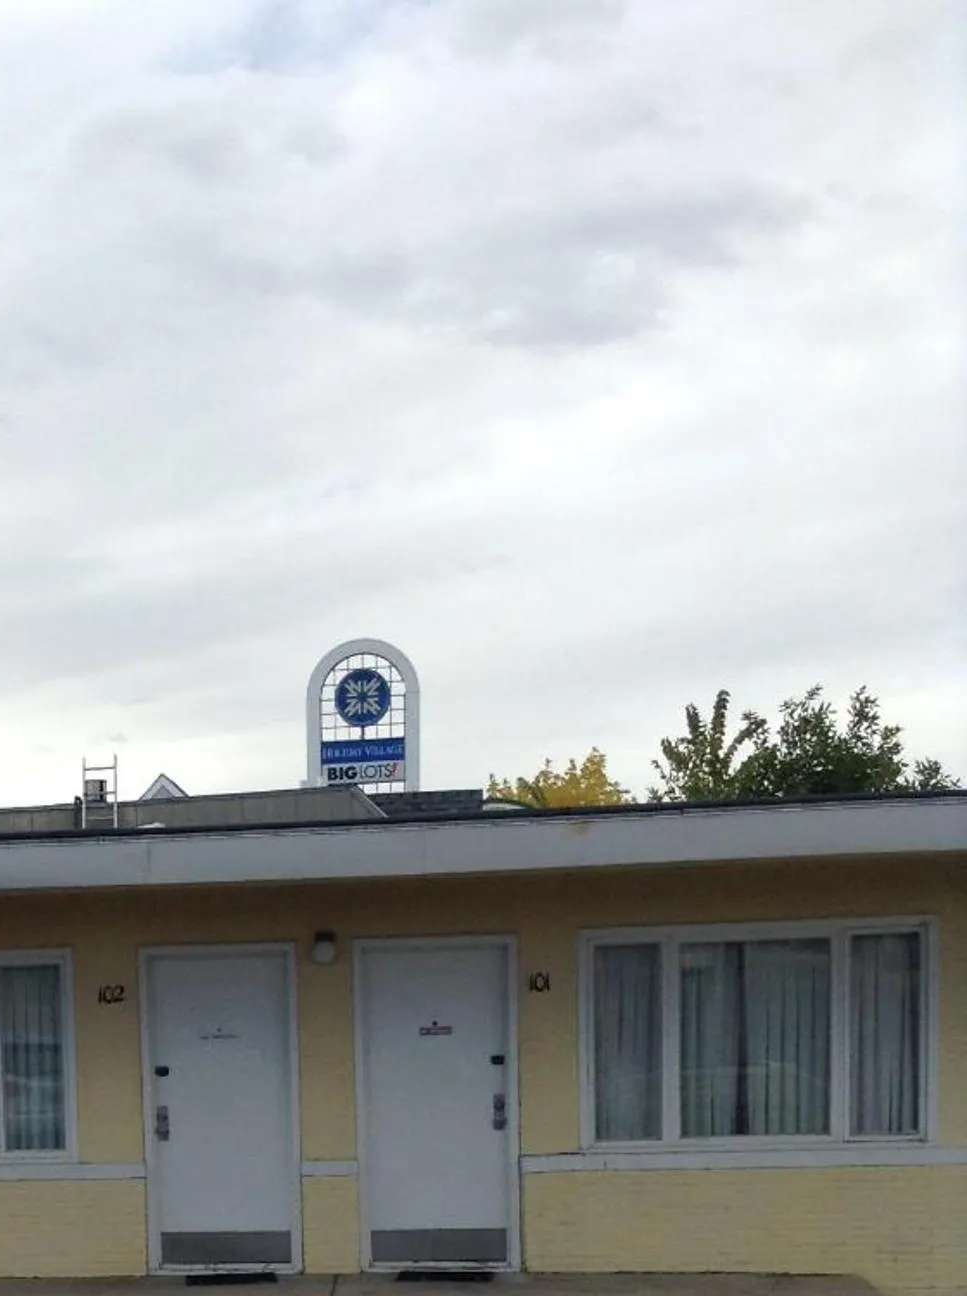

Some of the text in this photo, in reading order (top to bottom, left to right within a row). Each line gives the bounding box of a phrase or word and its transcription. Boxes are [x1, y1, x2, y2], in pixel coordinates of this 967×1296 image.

[327, 765, 358, 781] BIG
[529, 971, 551, 993] 101
[97, 984, 125, 1005] 102
